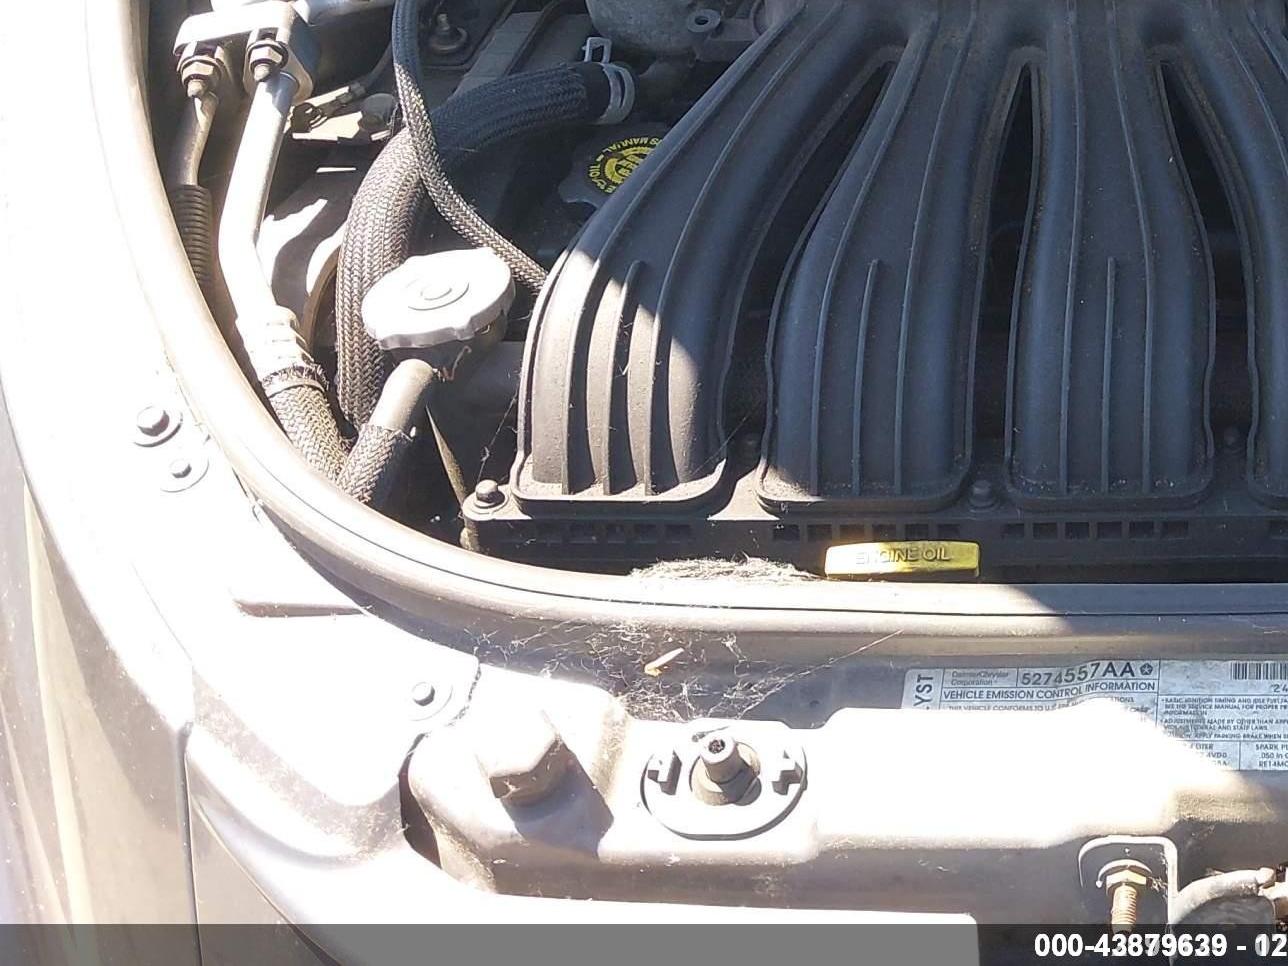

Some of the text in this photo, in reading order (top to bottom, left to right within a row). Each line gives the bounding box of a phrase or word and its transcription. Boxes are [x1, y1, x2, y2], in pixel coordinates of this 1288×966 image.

[855, 547, 951, 565] ENGINE OIL
[1020, 662, 1136, 686] 5274557AA
[914, 674, 934, 709] YST
[944, 681, 1155, 700] VEHICLE EMISSION CONTROL INFORMATION
